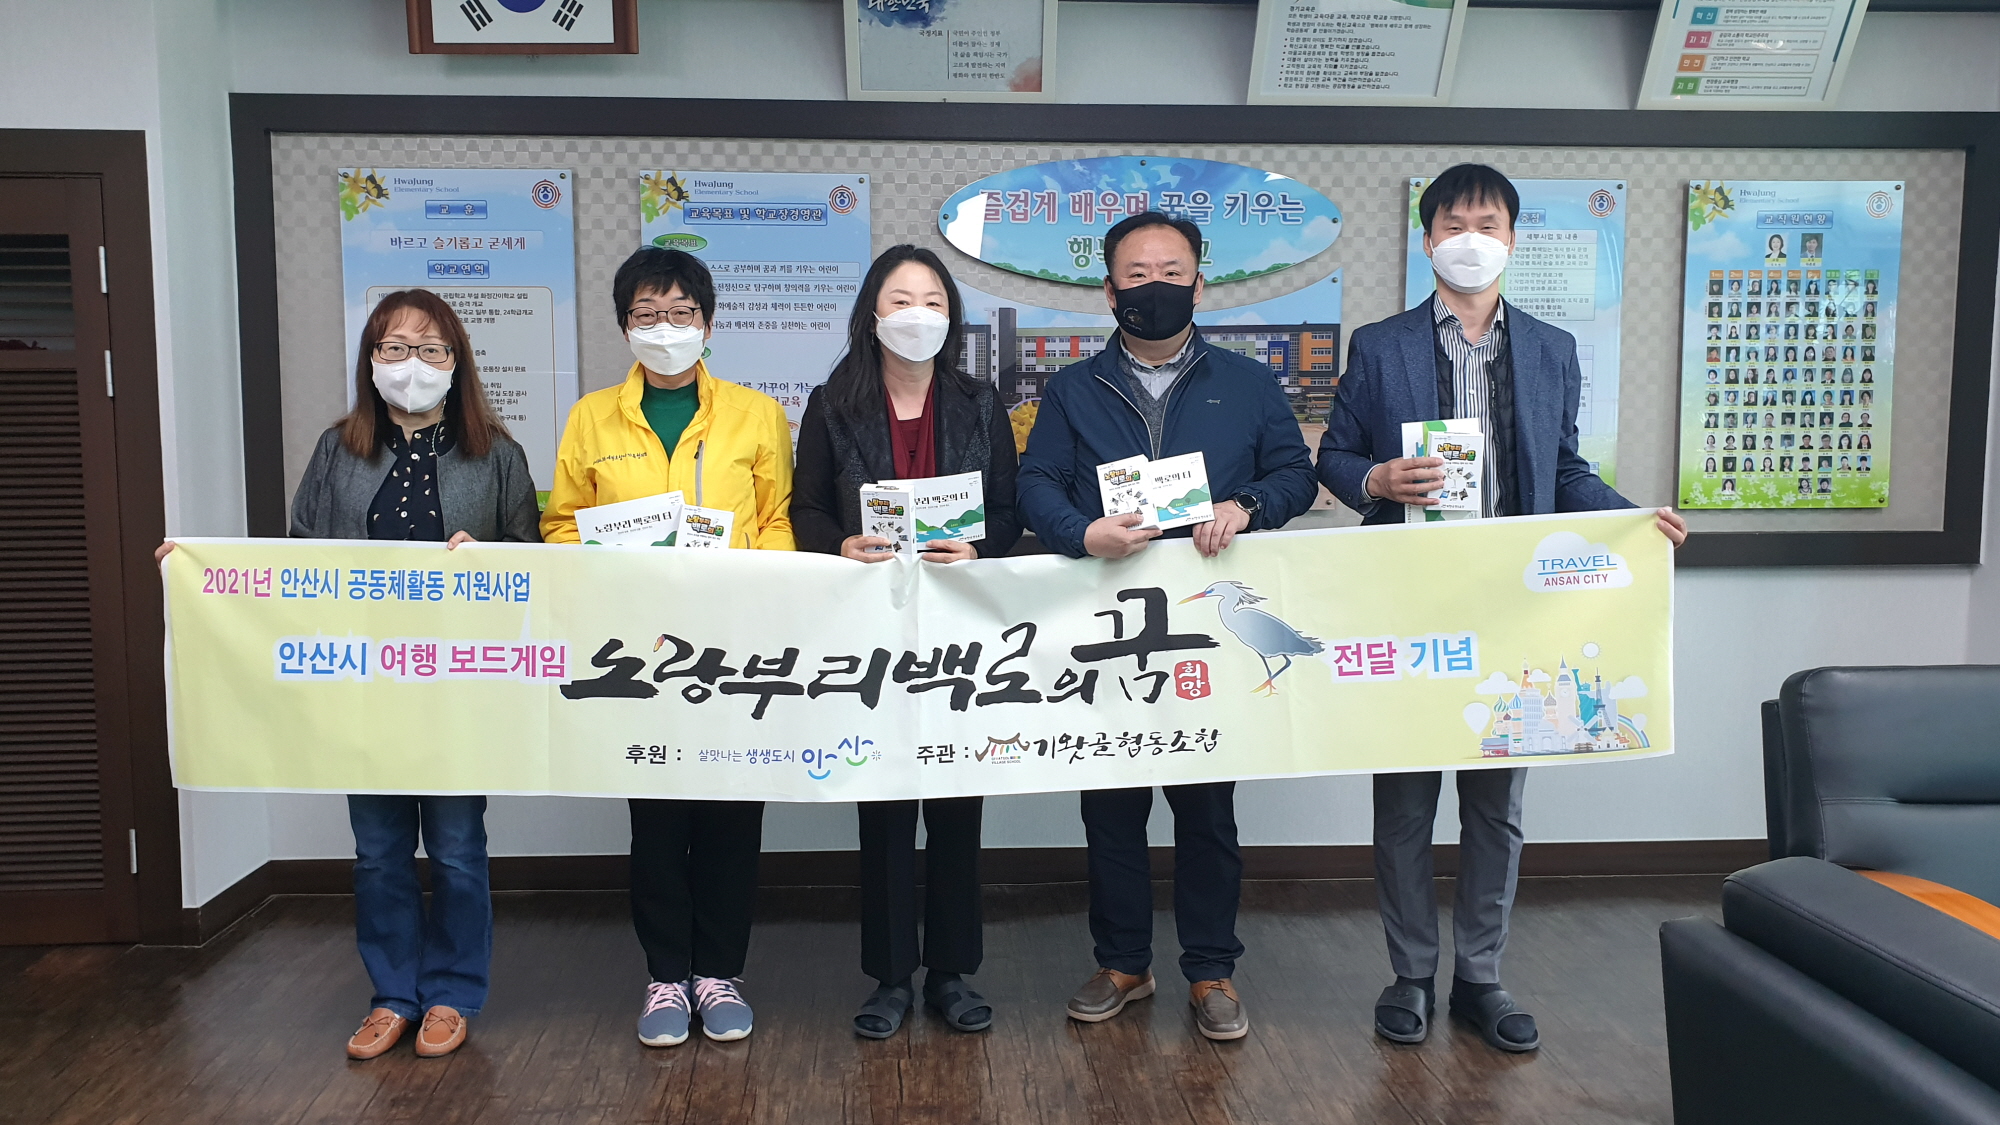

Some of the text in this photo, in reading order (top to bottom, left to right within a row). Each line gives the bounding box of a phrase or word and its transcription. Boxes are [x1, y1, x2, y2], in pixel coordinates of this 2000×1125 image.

[394, 178, 434, 187] HwaJung
[694, 180, 734, 189] HwaJung
[394, 186, 434, 194] Elementary
[694, 188, 734, 196] Elementary
[1739, 189, 1777, 198] HwaJung
[979, 190, 1057, 223] 즐겁게
[1069, 190, 1150, 224] 배우며
[1224, 193, 1305, 225] 키우는
[688, 207, 735, 220] 교육목표
[754, 208, 823, 222] 학교장경영관
[390, 236, 525, 250] 바르고 슬기롭고 굳세게
[663, 238, 698, 248] 교육목표
[433, 263, 486, 275] 학교연혁
[733, 264, 761, 274] 공부하며
[763, 264, 777, 274] 꿈과
[779, 265, 793, 274] 끼를
[796, 265, 816, 274] 키우는
[818, 265, 839, 274] 어린이
[715, 283, 857, 293] 전정신으로 탐구하며 창의력을 키우는 어린이
[716, 302, 837, 312] 화예술적 감성과 체력이 튼튼한 어린이
[734, 320, 755, 330] 배려와
[758, 321, 778, 330] 존중을
[781, 321, 808, 330] 실천하는
[810, 321, 831, 331] 어린이
[757, 382, 789, 393] 가꾸어
[1154, 472, 1181, 483] 백로의
[931, 494, 958, 505] 백로의
[595, 519, 632, 534] 노랑부리
[633, 513, 661, 527] 백로의
[1537, 554, 1618, 572] TRAVEL
[203, 567, 531, 603] 2021년 안산시 공동체활동 지원사업
[1543, 573, 1608, 587] ANSAN CITY
[279, 642, 566, 678] 안산시 여행 보드게임
[1333, 636, 1473, 677] 전달 기념
[1178, 662, 1206, 697] 희망
[625, 744, 668, 765] 후원
[698, 748, 744, 763] 살맛나는
[746, 748, 795, 764] 생생도시
[917, 744, 956, 765] 주관
